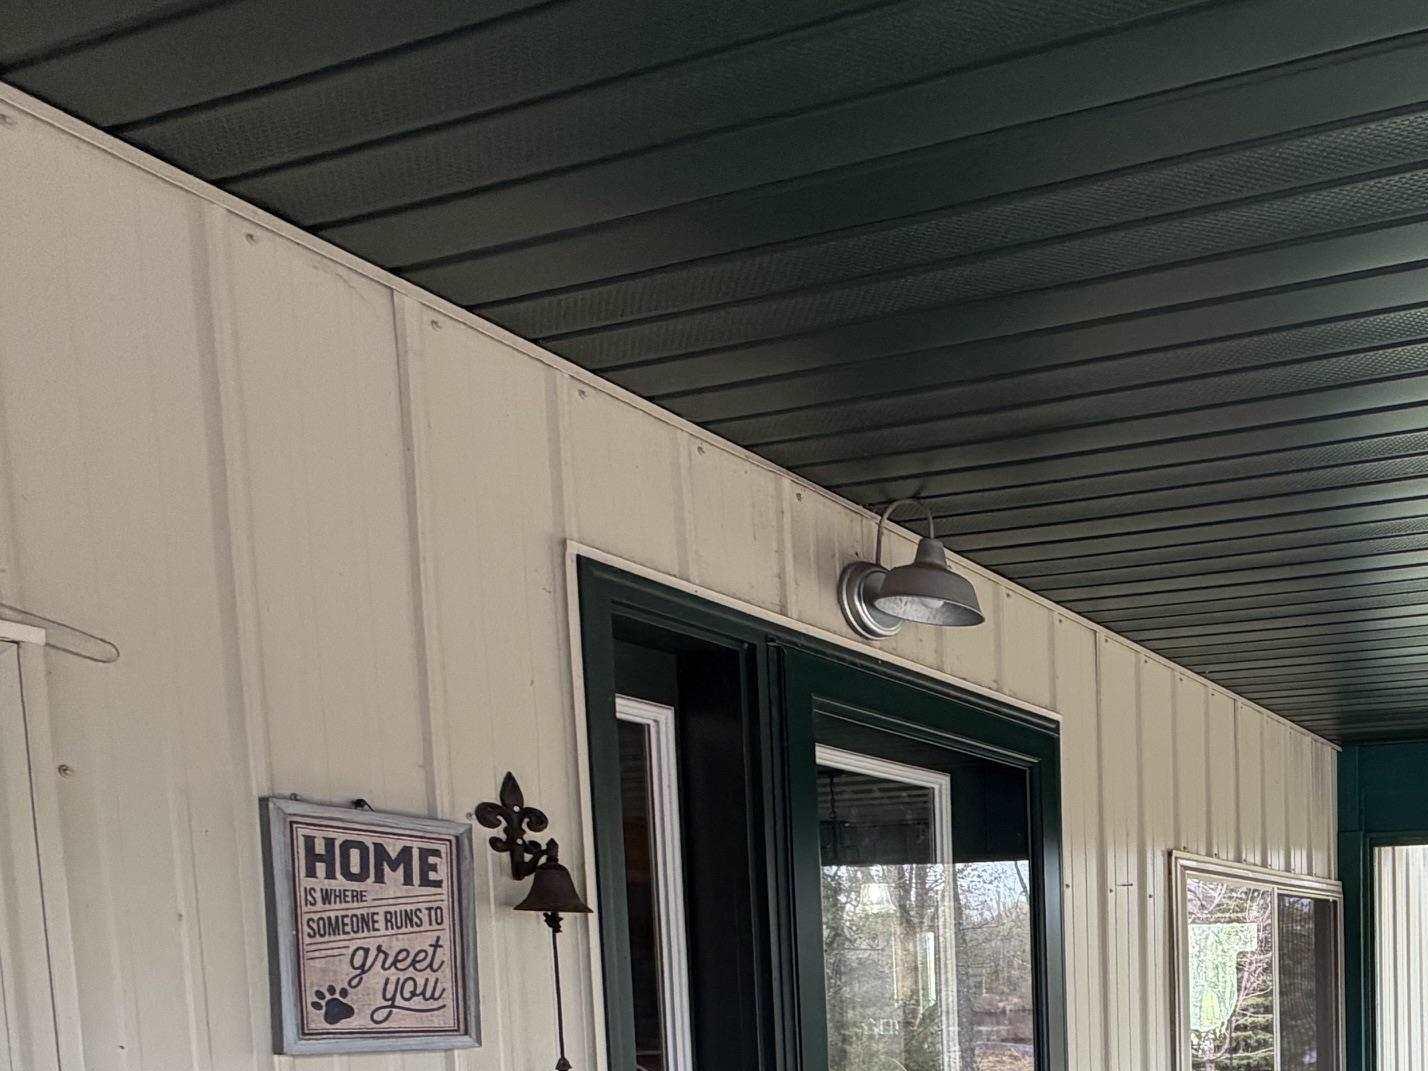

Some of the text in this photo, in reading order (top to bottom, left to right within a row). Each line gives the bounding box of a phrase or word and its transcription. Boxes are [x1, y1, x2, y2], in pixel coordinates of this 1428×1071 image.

[302, 834, 444, 888] HOME
[303, 887, 368, 907] IS WHERE
[306, 905, 444, 939] SOMEONE RUNS TO
[347, 935, 448, 989] greet
[370, 975, 447, 1025] you
